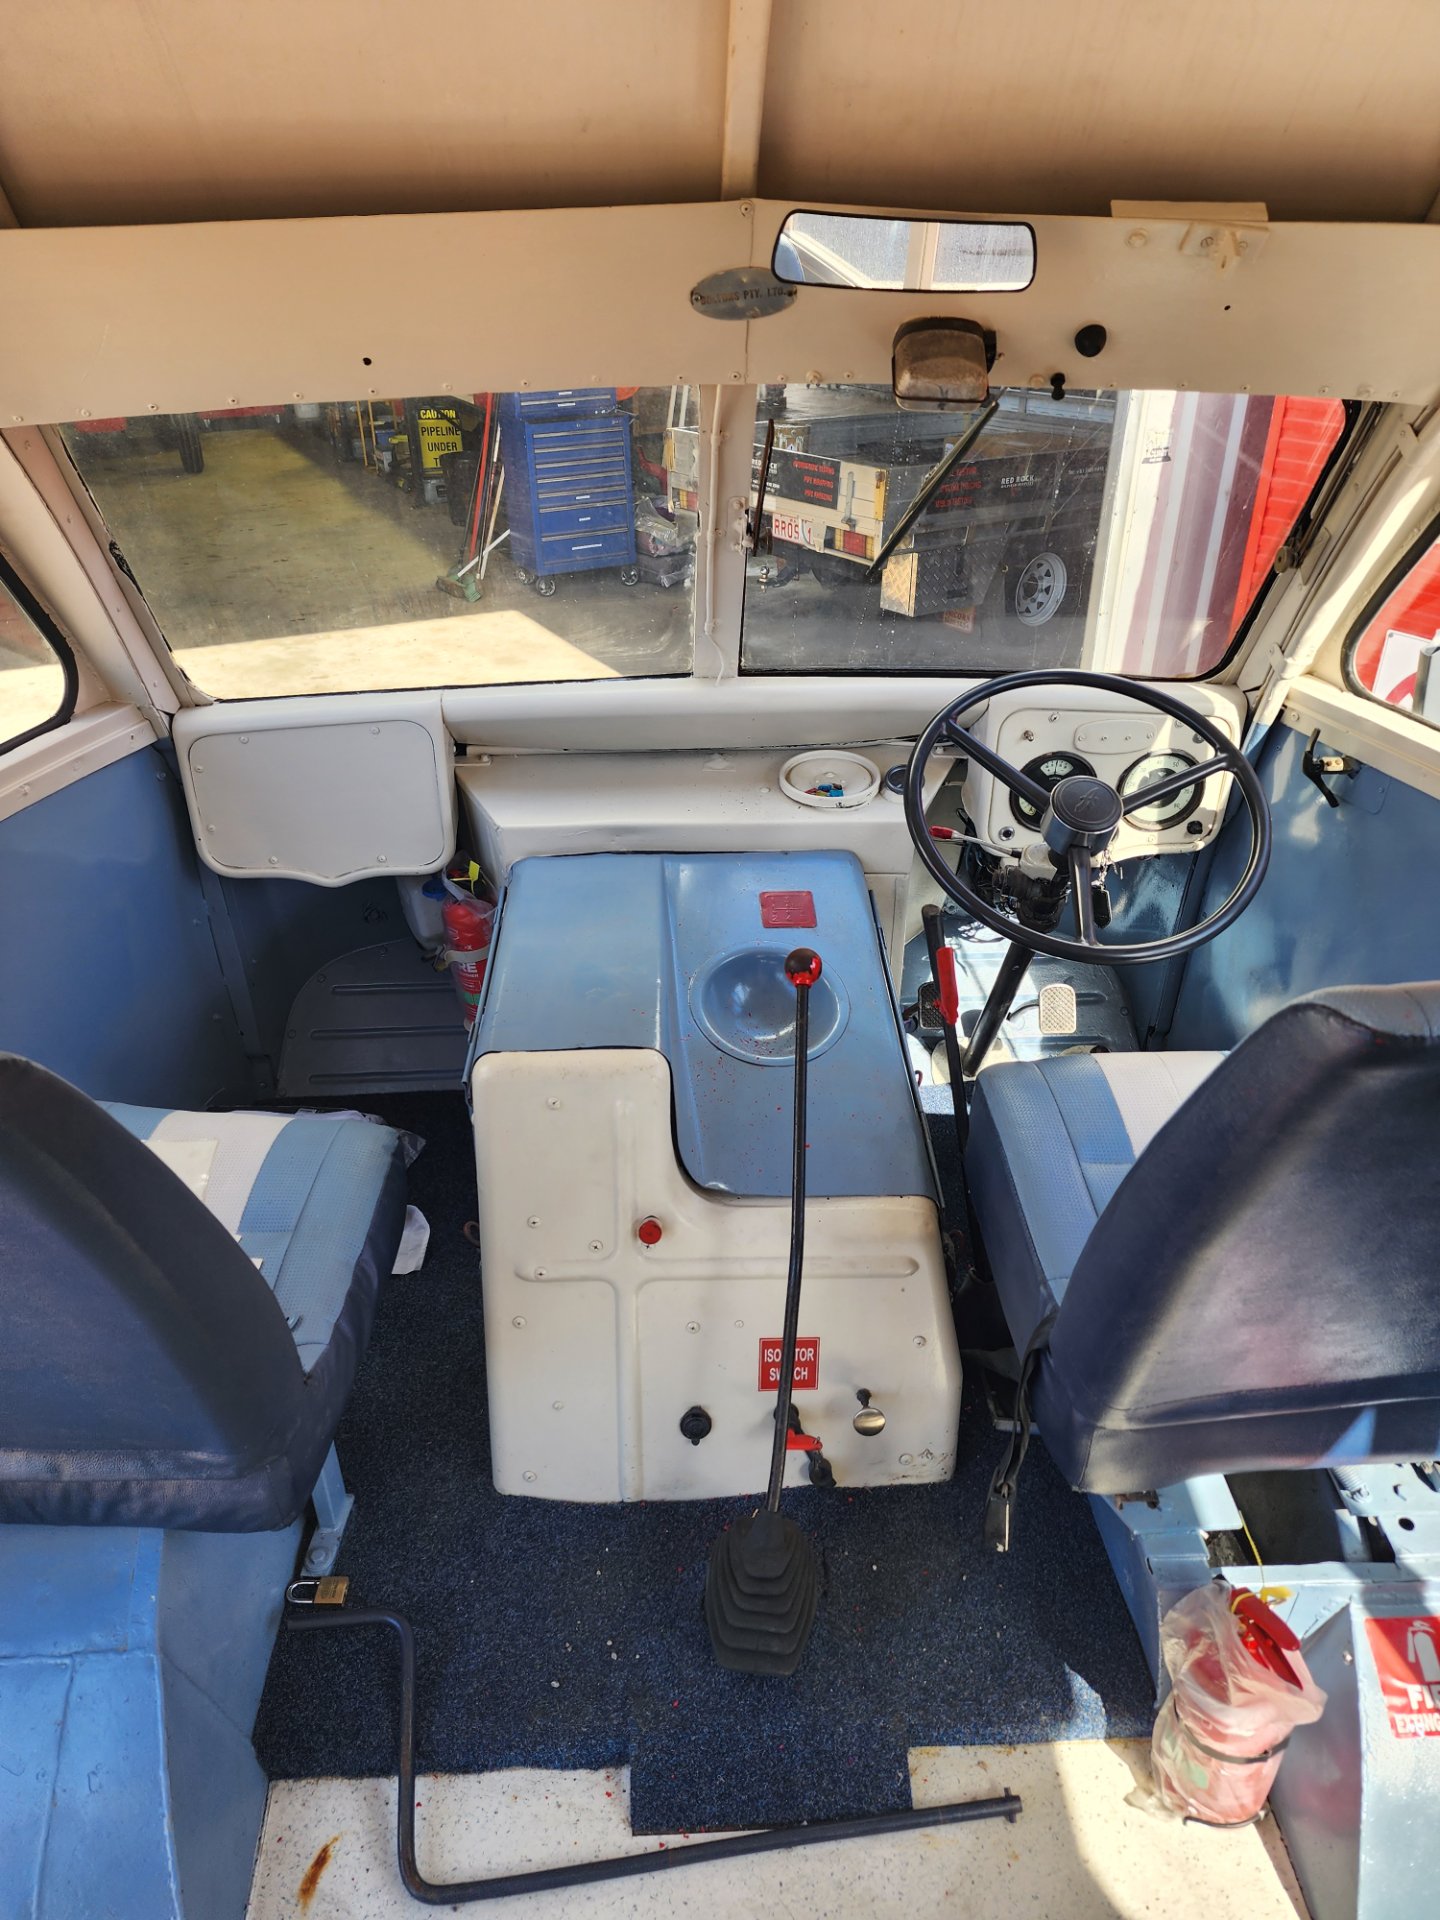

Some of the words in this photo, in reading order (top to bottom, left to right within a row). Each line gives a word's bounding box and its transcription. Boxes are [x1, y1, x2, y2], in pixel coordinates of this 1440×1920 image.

[420, 409, 456, 419] CAUON
[421, 426, 461, 437] PIPELINE
[427, 442, 458, 452] UNDER
[764, 1347, 814, 1362] ISOTOR
[769, 1366, 808, 1381] SCH
